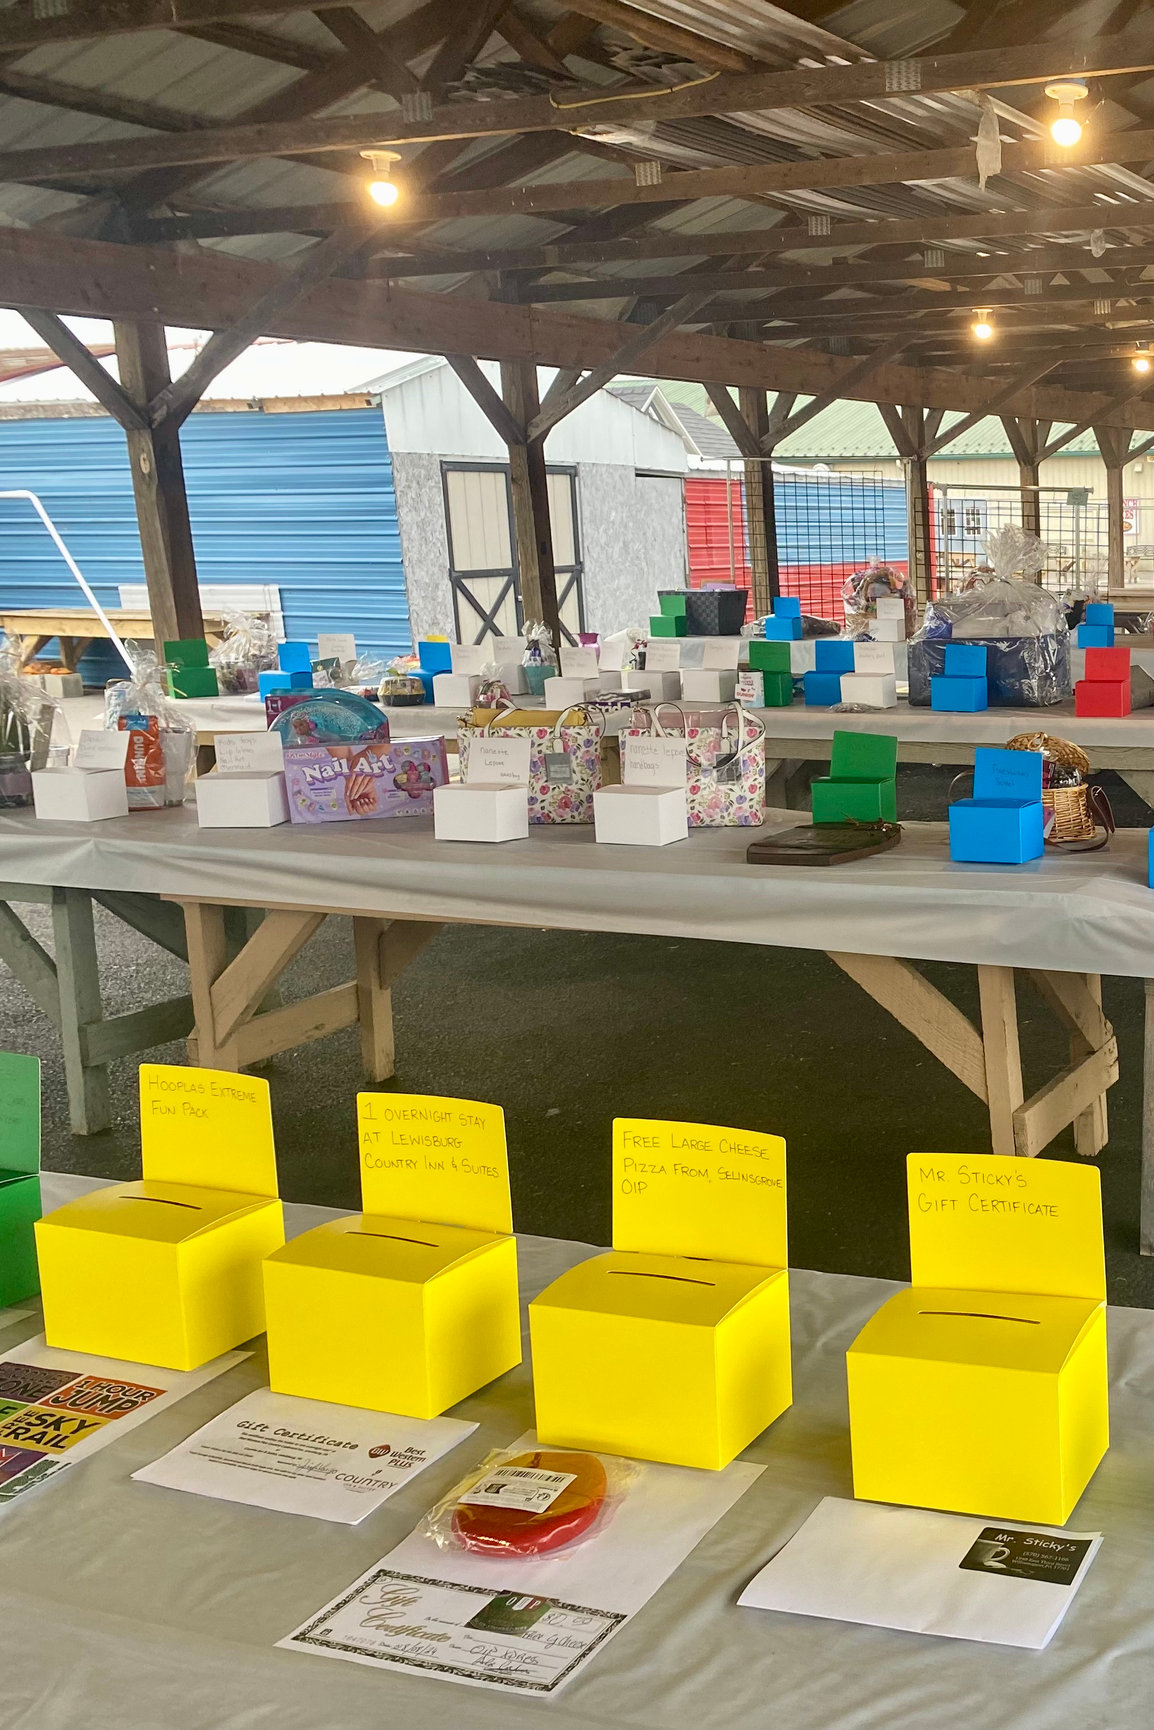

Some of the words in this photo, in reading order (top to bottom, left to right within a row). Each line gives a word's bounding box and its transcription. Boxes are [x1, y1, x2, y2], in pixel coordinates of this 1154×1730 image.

[302, 757, 350, 784] Nail
[355, 754, 396, 777] Art
[149, 1074, 206, 1095] HOOPLAS
[211, 1081, 257, 1104] EXTREME
[152, 1101, 176, 1116] FUN
[182, 1101, 209, 1119] PACK
[362, 1102, 377, 1121] 1
[384, 1107, 453, 1124] OVERNIGHT
[458, 1113, 486, 1131] STAY
[363, 1131, 381, 1144] AT
[391, 1130, 463, 1149] LEWISBURG
[623, 1131, 661, 1149] FREE
[671, 1133, 713, 1152] LARGE
[719, 1138, 770, 1160] CHEESE
[364, 1152, 418, 1170] COUNTRY
[424, 1155, 445, 1171] INN
[461, 1158, 500, 1179] SUITES
[623, 1157, 667, 1175] PIZZA
[717, 1166, 784, 1189] SELINSGROVE
[957, 1164, 1028, 1188] STICKY'S
[621, 1178, 648, 1195] OIP
[917, 1192, 958, 1213] GIFT
[968, 1192, 1060, 1218] CERTIFICATE
[0, 1378, 53, 1399] ONE
[90, 1382, 157, 1402] HOUR
[50, 1389, 141, 1416] JUMP
[25, 1413, 102, 1436] SKY
[237, 1420, 269, 1433] Gift
[273, 1427, 359, 1450] Certificate
[3, 1427, 71, 1449] RAIL
[389, 1451, 427, 1463] Western
[404, 1446, 426, 1456] Best
[387, 1458, 415, 1468] PLUS
[335, 1472, 398, 1490] COUNTRY
[994, 1533, 1017, 1544] Mr.
[1023, 1537, 1078, 1552] Sticky's
